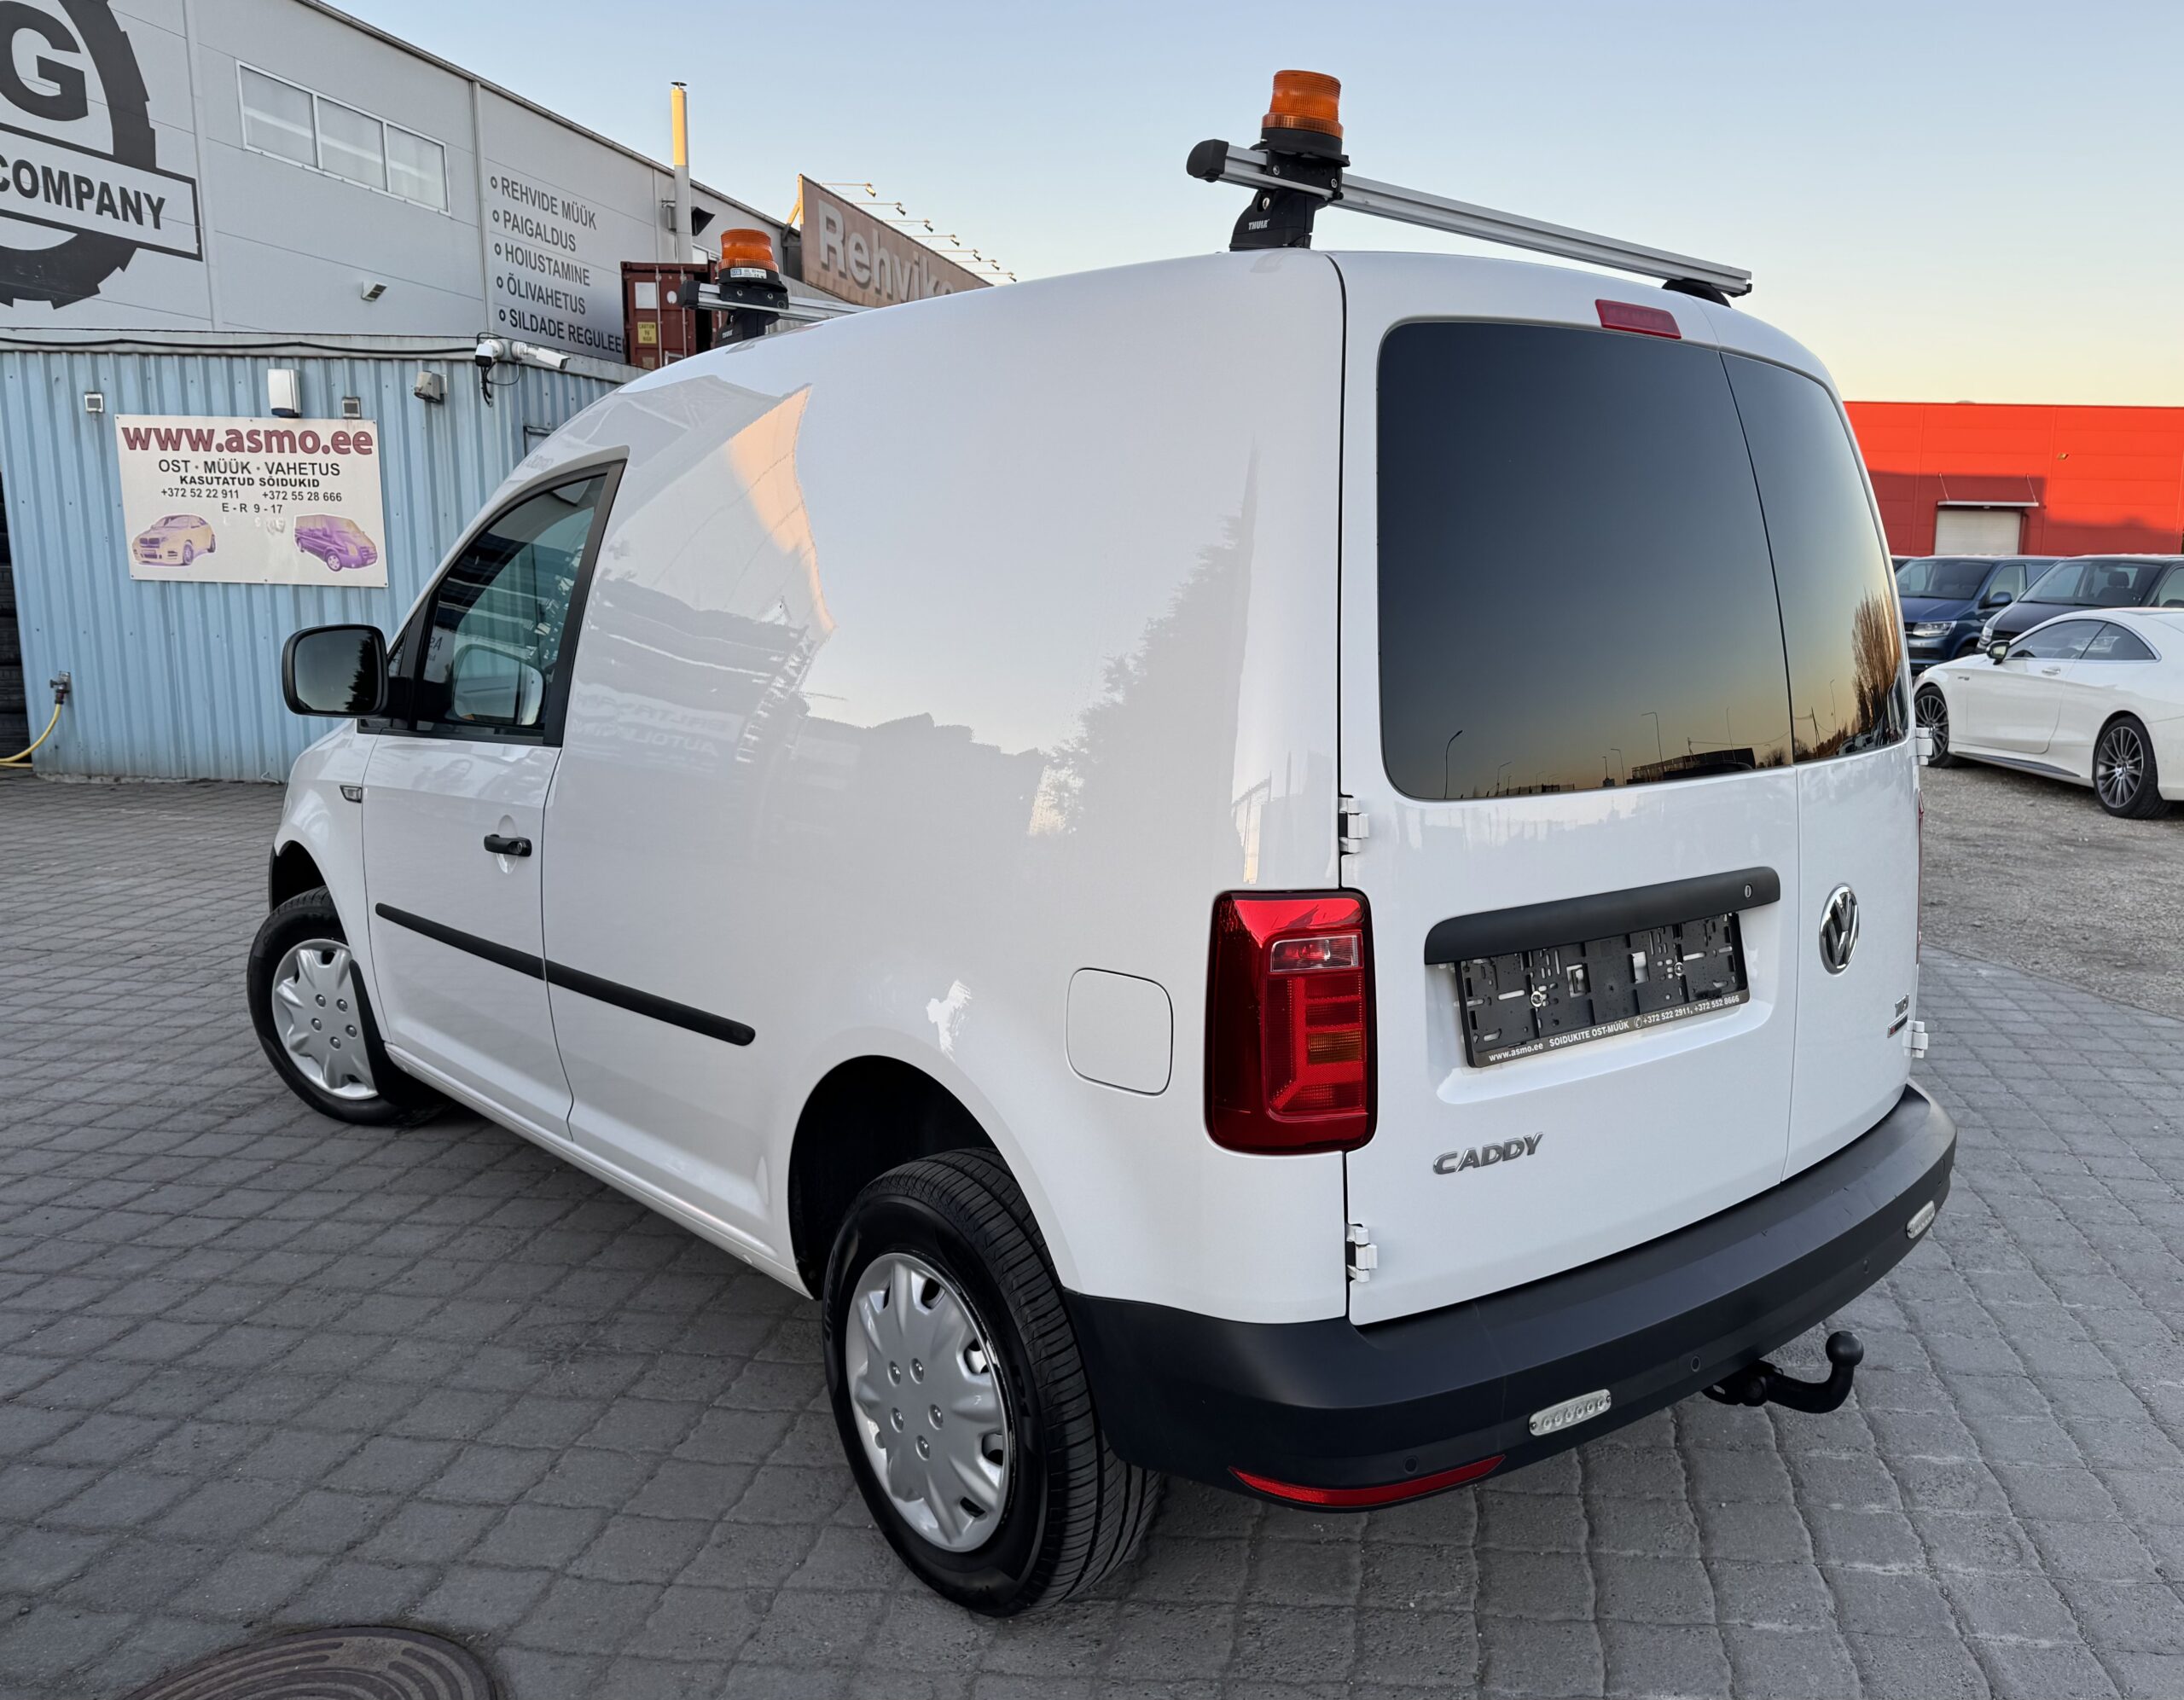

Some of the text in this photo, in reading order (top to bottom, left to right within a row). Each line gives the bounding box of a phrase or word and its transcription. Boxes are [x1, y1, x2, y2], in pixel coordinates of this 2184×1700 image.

[0, 0, 88, 121] G
[501, 177, 596, 230] REHVIDE MÜÜK
[503, 210, 576, 252] PAIGALDUS
[1248, 219, 1269, 230] THULE
[505, 242, 590, 287] HOIUSTAMINE
[508, 272, 586, 315] ÕLIVAHETUS
[509, 309, 565, 339] SILDADE
[121, 426, 374, 455] www.asmo.ee
[158, 457, 340, 476] OST MÜÜK VAHETUS
[161, 488, 240, 499] +372 52 22 911
[179, 475, 320, 488] KASUTATUD SÕIDUKID
[262, 490, 343, 502] +372 55 28 666
[222, 502, 229, 513] E
[240, 503, 248, 513] R
[253, 504, 260, 513] 9
[271, 504, 283, 513] 17
[1643, 995, 1740, 1024] +372 522 2911, +372 552 8666
[1489, 1042, 1544, 1062] www.asmo.ee
[1592, 1019, 1630, 1037] OST-MÜÜK
[1433, 1131, 1544, 1175] CADDY
